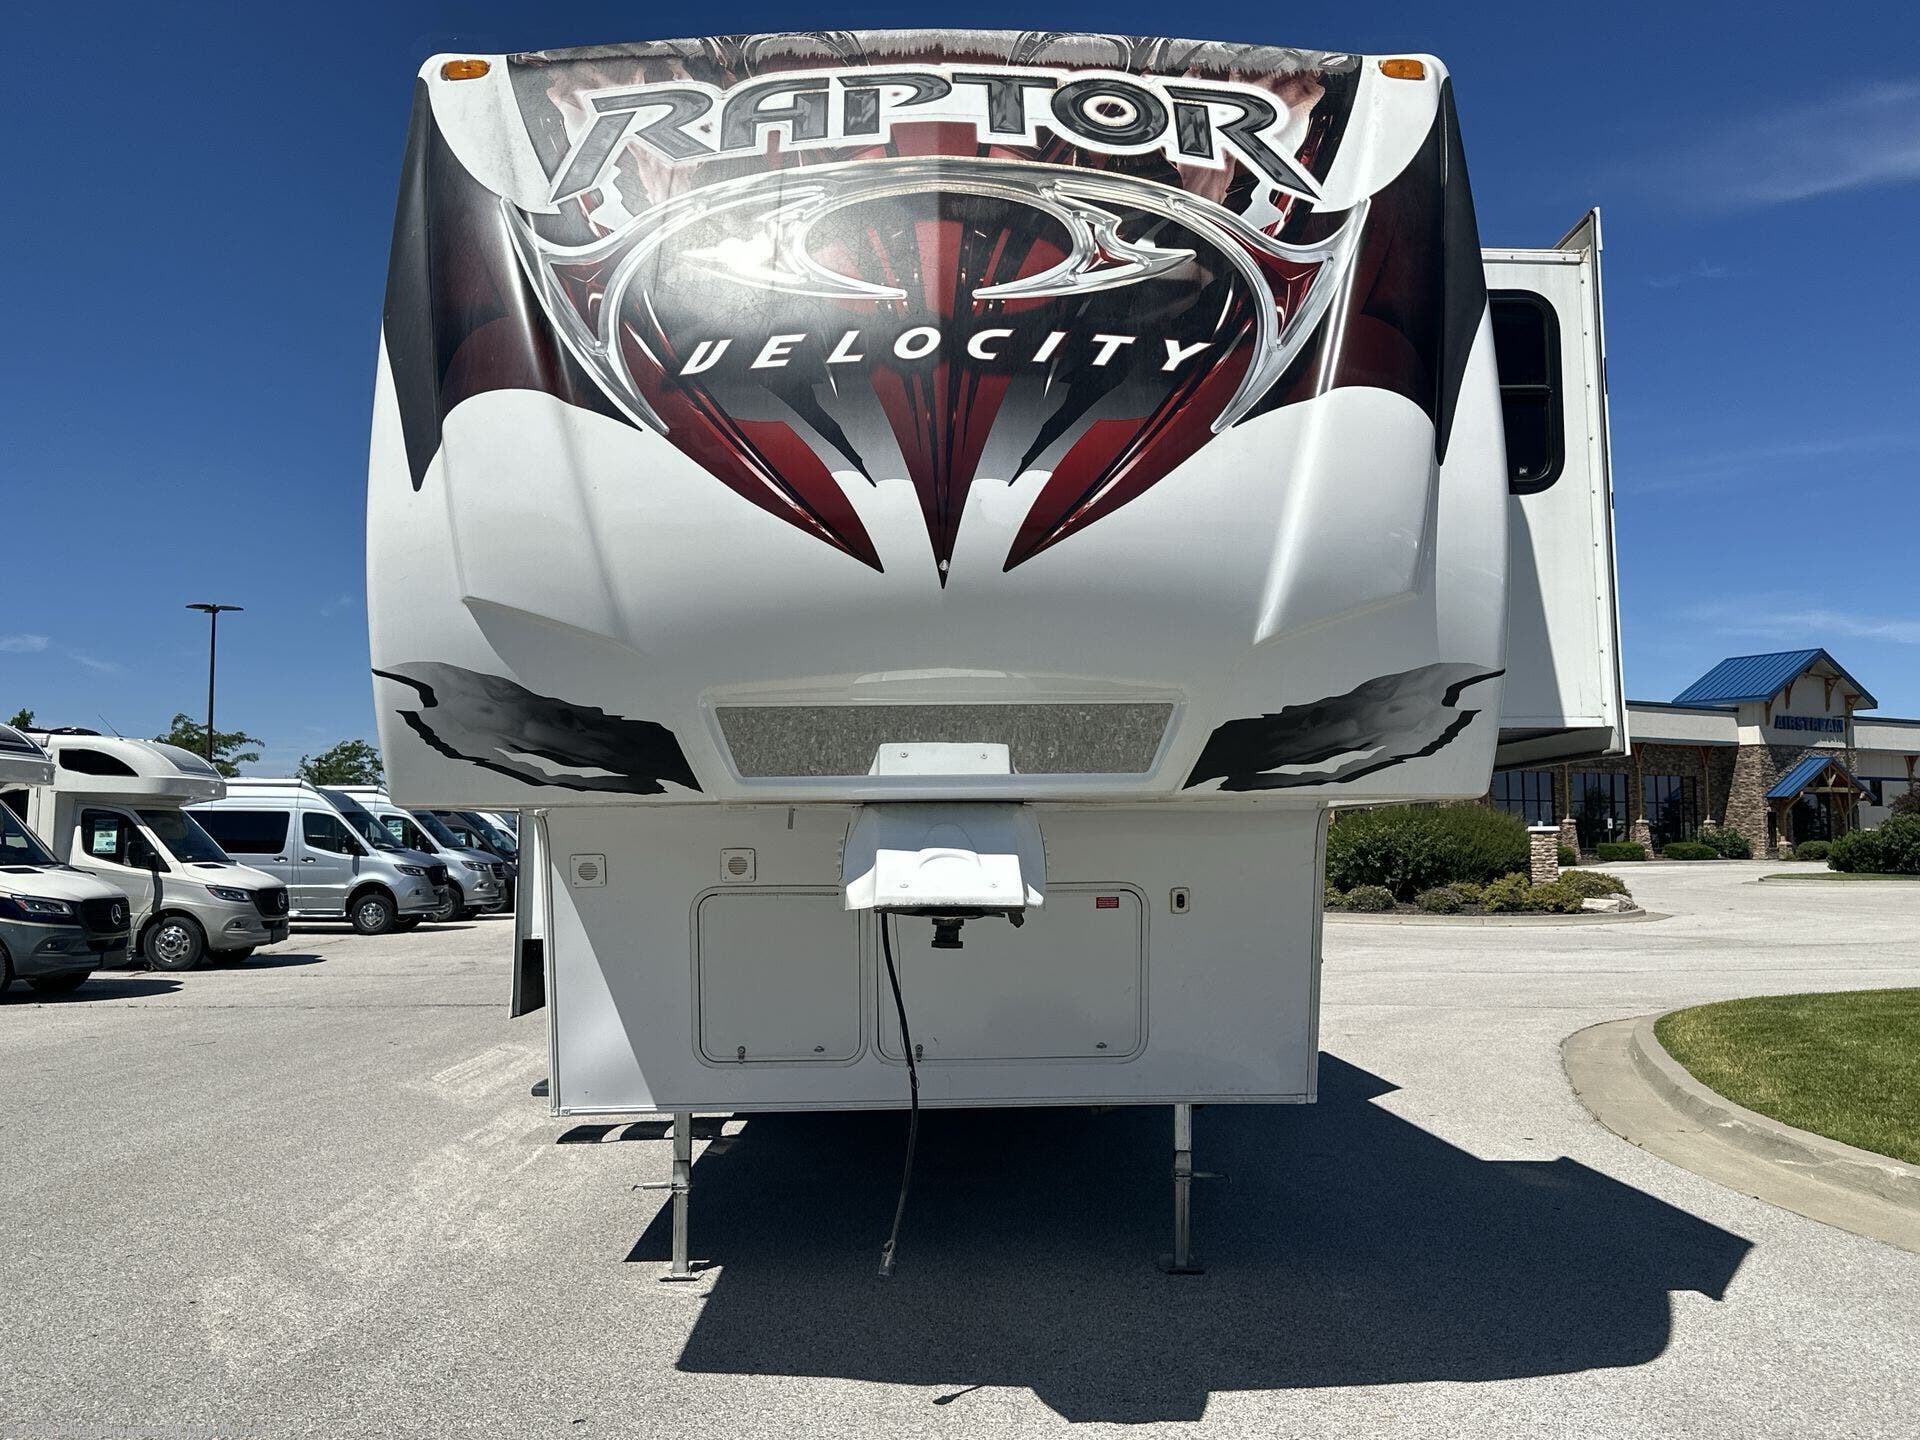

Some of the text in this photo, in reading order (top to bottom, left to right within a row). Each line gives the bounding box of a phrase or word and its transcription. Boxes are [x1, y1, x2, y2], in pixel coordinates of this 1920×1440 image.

[550, 73, 1321, 203] RAPTOR
[680, 326, 1214, 375] VELOCITY
[1774, 715, 1843, 732] AIRSTREAM
